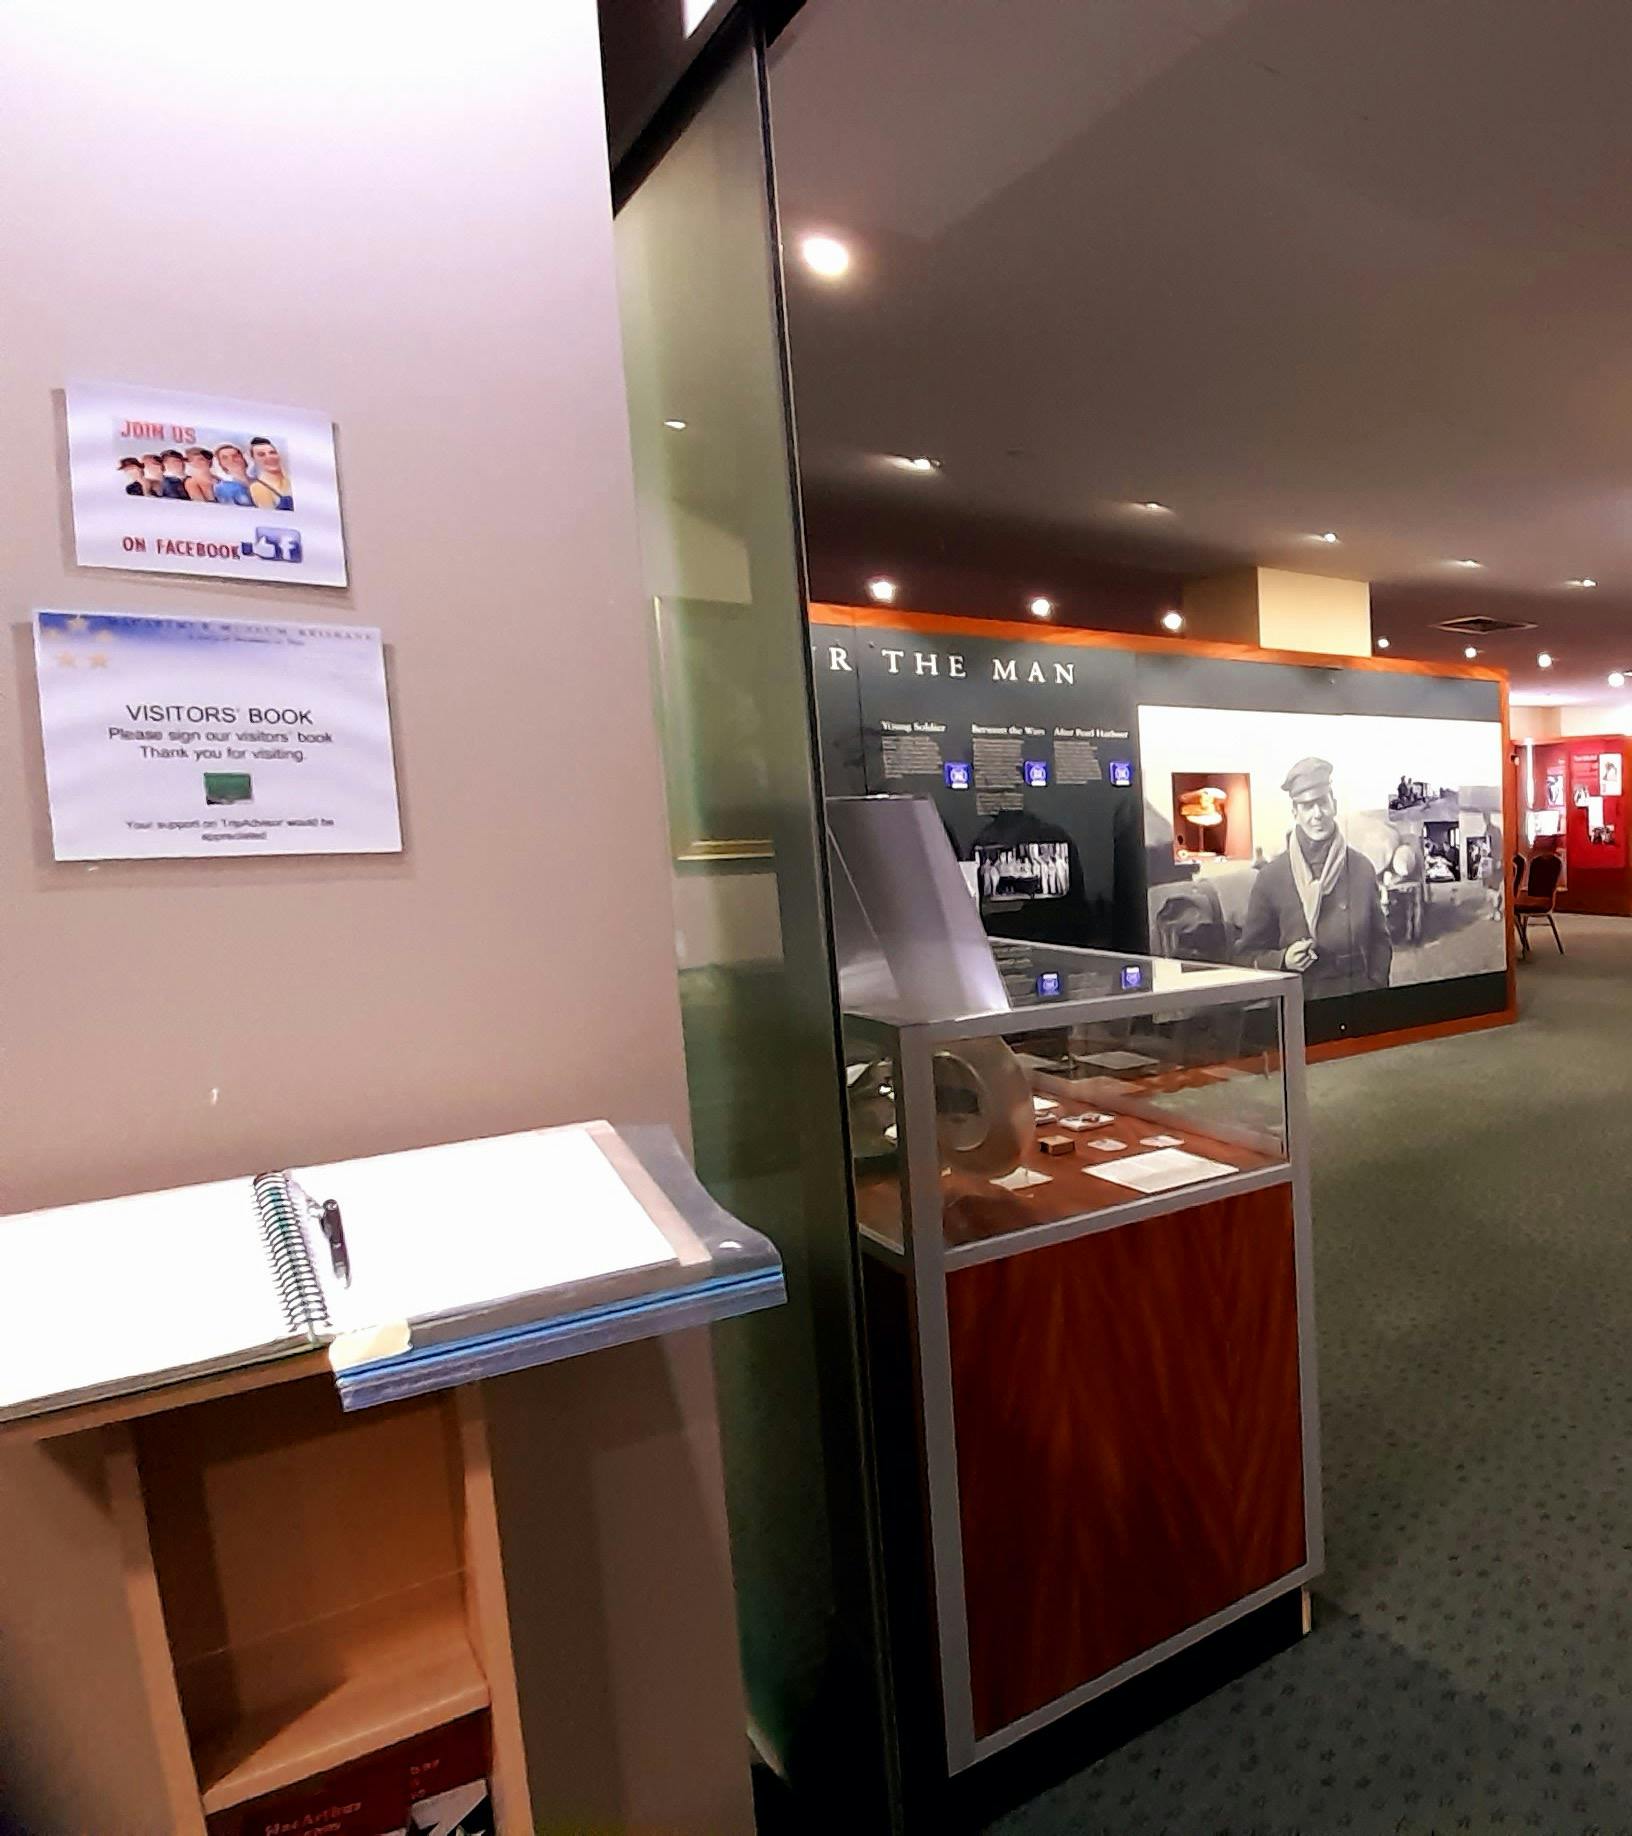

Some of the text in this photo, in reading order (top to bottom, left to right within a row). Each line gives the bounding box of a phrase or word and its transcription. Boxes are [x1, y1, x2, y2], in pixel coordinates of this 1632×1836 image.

[121, 421, 197, 444] JOIN US
[123, 536, 241, 560] ON FACEBOOK
[881, 649, 967, 677] THE
[992, 658, 1075, 685] MAN
[126, 704, 314, 725] VISITORS' BOOK
[108, 727, 163, 741] Please
[168, 732, 201, 744] sign
[205, 732, 230, 741] our
[297, 732, 332, 743] book
[913, 722, 947, 732] Soldier
[140, 745, 189, 758] Thank
[194, 749, 222, 762] you
[227, 747, 245, 759] for
